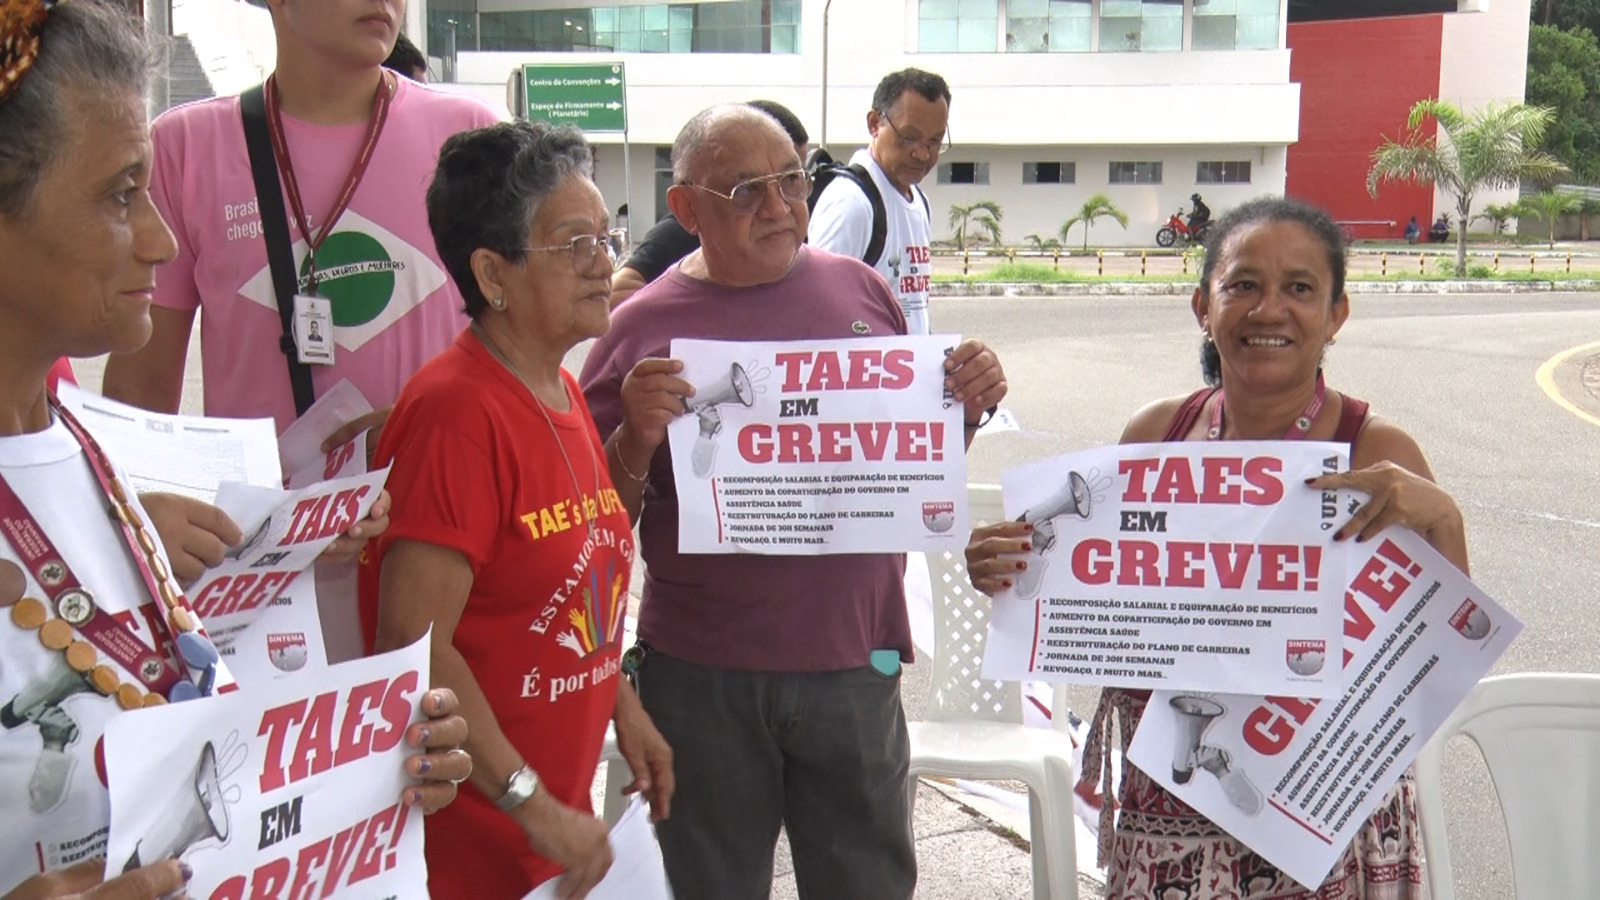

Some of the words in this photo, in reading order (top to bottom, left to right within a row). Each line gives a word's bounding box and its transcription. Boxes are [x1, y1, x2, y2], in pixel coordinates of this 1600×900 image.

[553, 78, 561, 86] de
[562, 78, 601, 86] Convenções
[531, 102, 554, 110] Espaço
[564, 101, 604, 109] Firmamento
[224, 196, 259, 221] Brasi
[290, 215, 313, 229] vz
[775, 350, 915, 393] TAES
[779, 398, 819, 418] EM
[737, 421, 945, 464] GREVE!
[723, 476, 783, 485] RECOMPOSIÇÃO
[831, 473, 887, 483] EQUIPARAÇÃO
[900, 473, 945, 481] BENEFÍCIOS
[1118, 456, 1284, 506] TAES
[1321, 456, 1338, 519] UEA
[777, 487, 842, 496] COPARTICIPAÇÃO
[857, 486, 895, 494] GOVERNO
[276, 484, 371, 548] TAES
[727, 512, 797, 520] REESTRUTURAÇÃO
[1119, 510, 1167, 532] EM
[594, 528, 615, 548] EM
[794, 524, 834, 532] SEMANAIS
[1071, 538, 1322, 591] GREVE!
[1049, 598, 1121, 610] RECOMPOSIÇÃO
[1123, 601, 1168, 610] SALARIAL
[1170, 603, 1177, 611] E
[1179, 603, 1244, 614] EQUIPARAÇÃO
[1246, 605, 1259, 613] DE
[1261, 605, 1318, 614] BENEFÍCIOS
[1048, 626, 1107, 635] ASSISTÊNCIA
[1109, 627, 1140, 636] SAÚDE
[1049, 612, 1095, 621] AUMENTO
[1097, 613, 1110, 622] DA
[1112, 613, 1190, 626] COPARTICIPAÇÃO
[1192, 617, 1205, 625] DO
[1208, 618, 1254, 627] GOVERNO
[1256, 619, 1271, 627] EM
[268, 634, 304, 644] SINTEMA
[1046, 639, 1131, 651] REESTRUTURAÇÃO
[1147, 643, 1180, 652] PLANO
[1196, 645, 1250, 655] CARREIRAS
[1045, 652, 1089, 661] JORNADA
[1091, 654, 1103, 662] DE
[1105, 655, 1123, 663] 30H
[1125, 656, 1175, 665] SEMANAIS
[1095, 667, 1101, 675] E
[1103, 668, 1135, 677] MUITO
[520, 666, 541, 698] É
[549, 671, 588, 703] por
[1274, 733, 1323, 792] RECOMPOSIÇÃO
[1320, 695, 1352, 732] SALARIAL
[1354, 634, 1399, 688] EQUIPARAÇÃO
[1395, 622, 1407, 634] DE
[1405, 581, 1440, 623] BENEFÍCIOS
[1287, 762, 1319, 800] AUMENTO
[1317, 748, 1329, 761] DA
[1324, 683, 1379, 749] COPARTICIPAÇÃO
[1375, 670, 1388, 684] DO
[1386, 635, 1417, 671] GOVERNO
[1414, 622, 1427, 635] EM
[257, 670, 419, 794] TAES
[1309, 746, 1367, 816] REESTRUTURAÇÃO
[1363, 733, 1376, 746] DO
[1373, 707, 1396, 733] PLANO
[1394, 696, 1406, 708] DE
[1404, 655, 1438, 696] CARREIRAS
[1322, 787, 1353, 823] JORNADA
[1350, 774, 1362, 786] DE
[1358, 758, 1375, 775] 30H
[1372, 718, 1406, 758] SEMANAIS
[1371, 757, 1394, 782] MUITO
[1297, 758, 1340, 808] ASSISTÊNCIA
[258, 795, 303, 851] EM
[61, 839, 108, 864] REESTRUT
